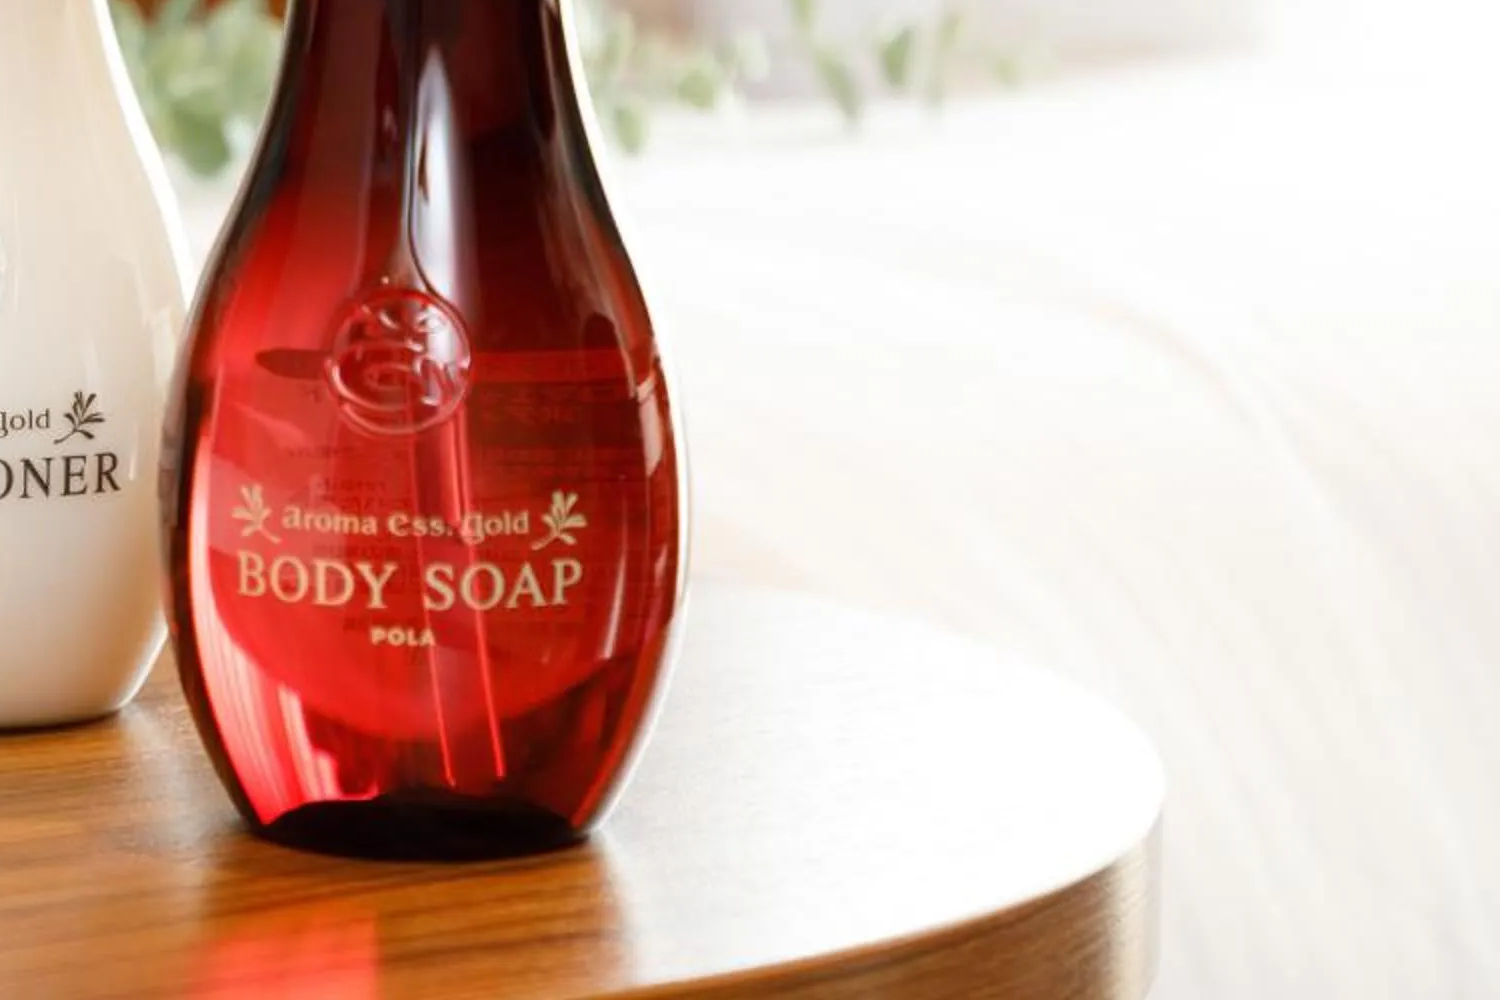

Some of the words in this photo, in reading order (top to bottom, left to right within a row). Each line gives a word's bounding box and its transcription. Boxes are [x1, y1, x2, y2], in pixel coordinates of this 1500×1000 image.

[283, 506, 378, 536] aroma
[461, 511, 530, 545] gold
[237, 550, 399, 610] BODY
[423, 558, 583, 612] SOAP
[372, 628, 435, 648] POLA
